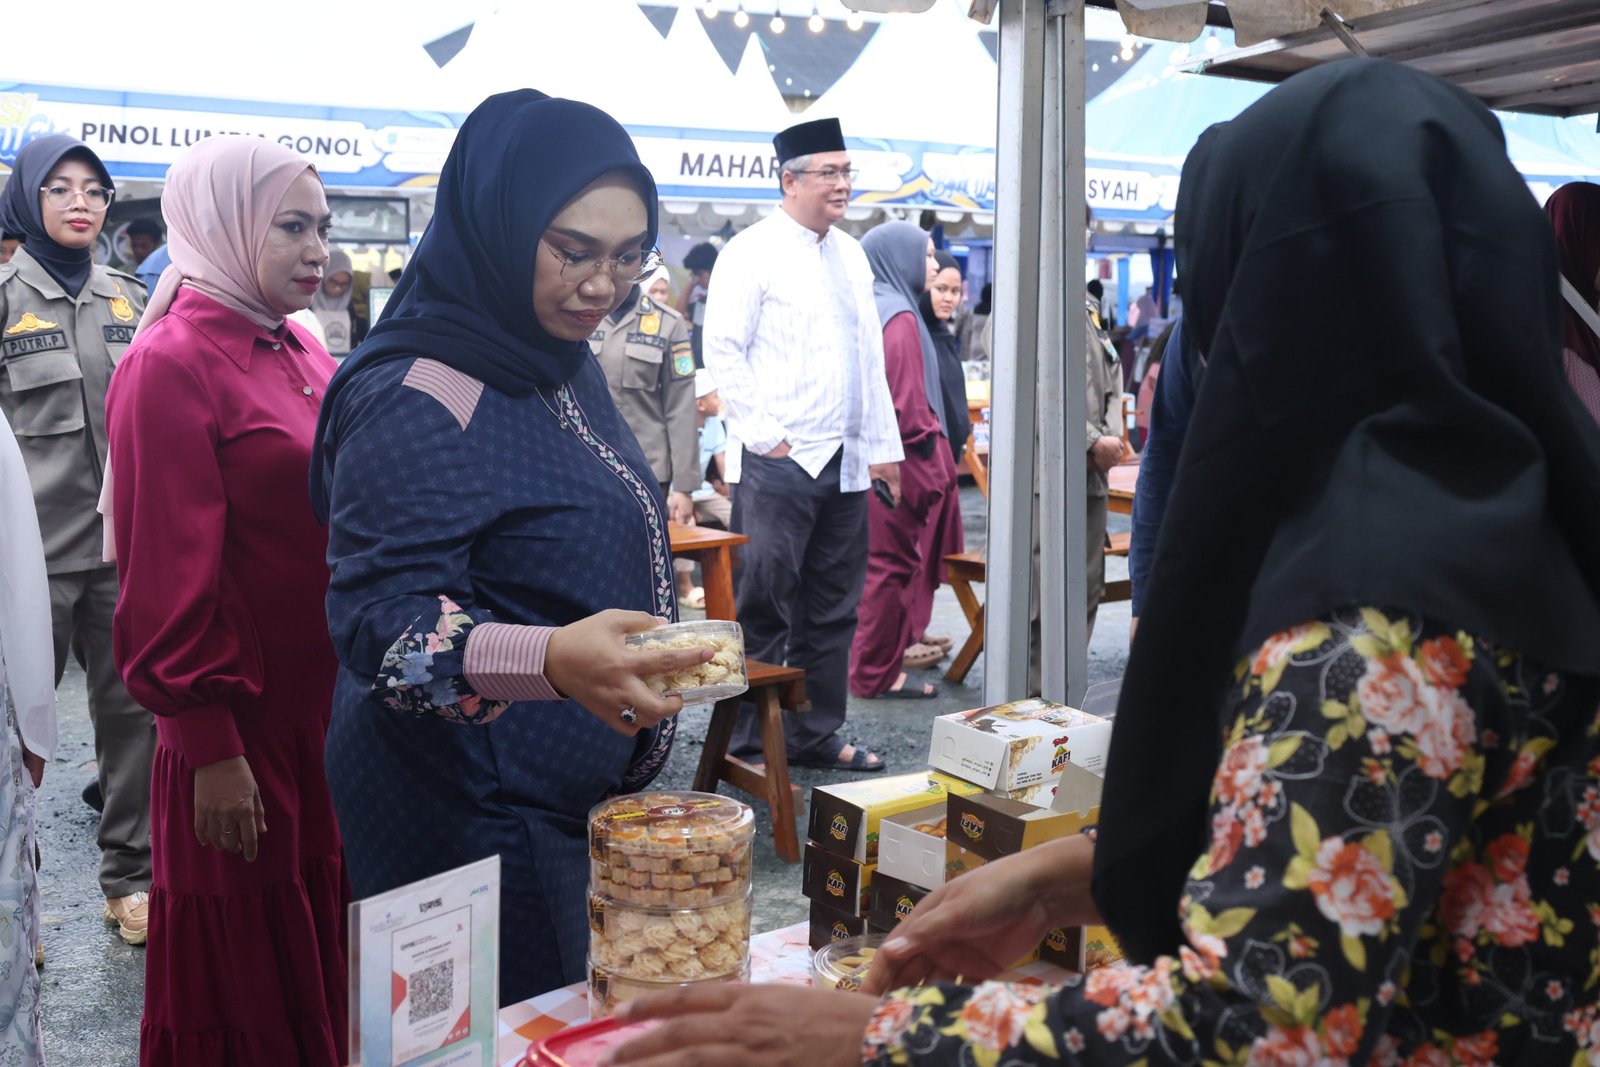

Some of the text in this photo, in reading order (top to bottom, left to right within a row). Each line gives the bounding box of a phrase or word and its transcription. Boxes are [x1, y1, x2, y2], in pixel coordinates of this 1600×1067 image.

[81, 122, 163, 146] PINOL
[1088, 179, 1138, 201] SYAH
[10, 335, 59, 353] PUTRI.P
[1051, 751, 1071, 769] KAFI
[831, 821, 849, 835] KAFI
[961, 818, 984, 834] KAFI
[827, 877, 846, 892] KAFI
[896, 904, 914, 915] KAF
